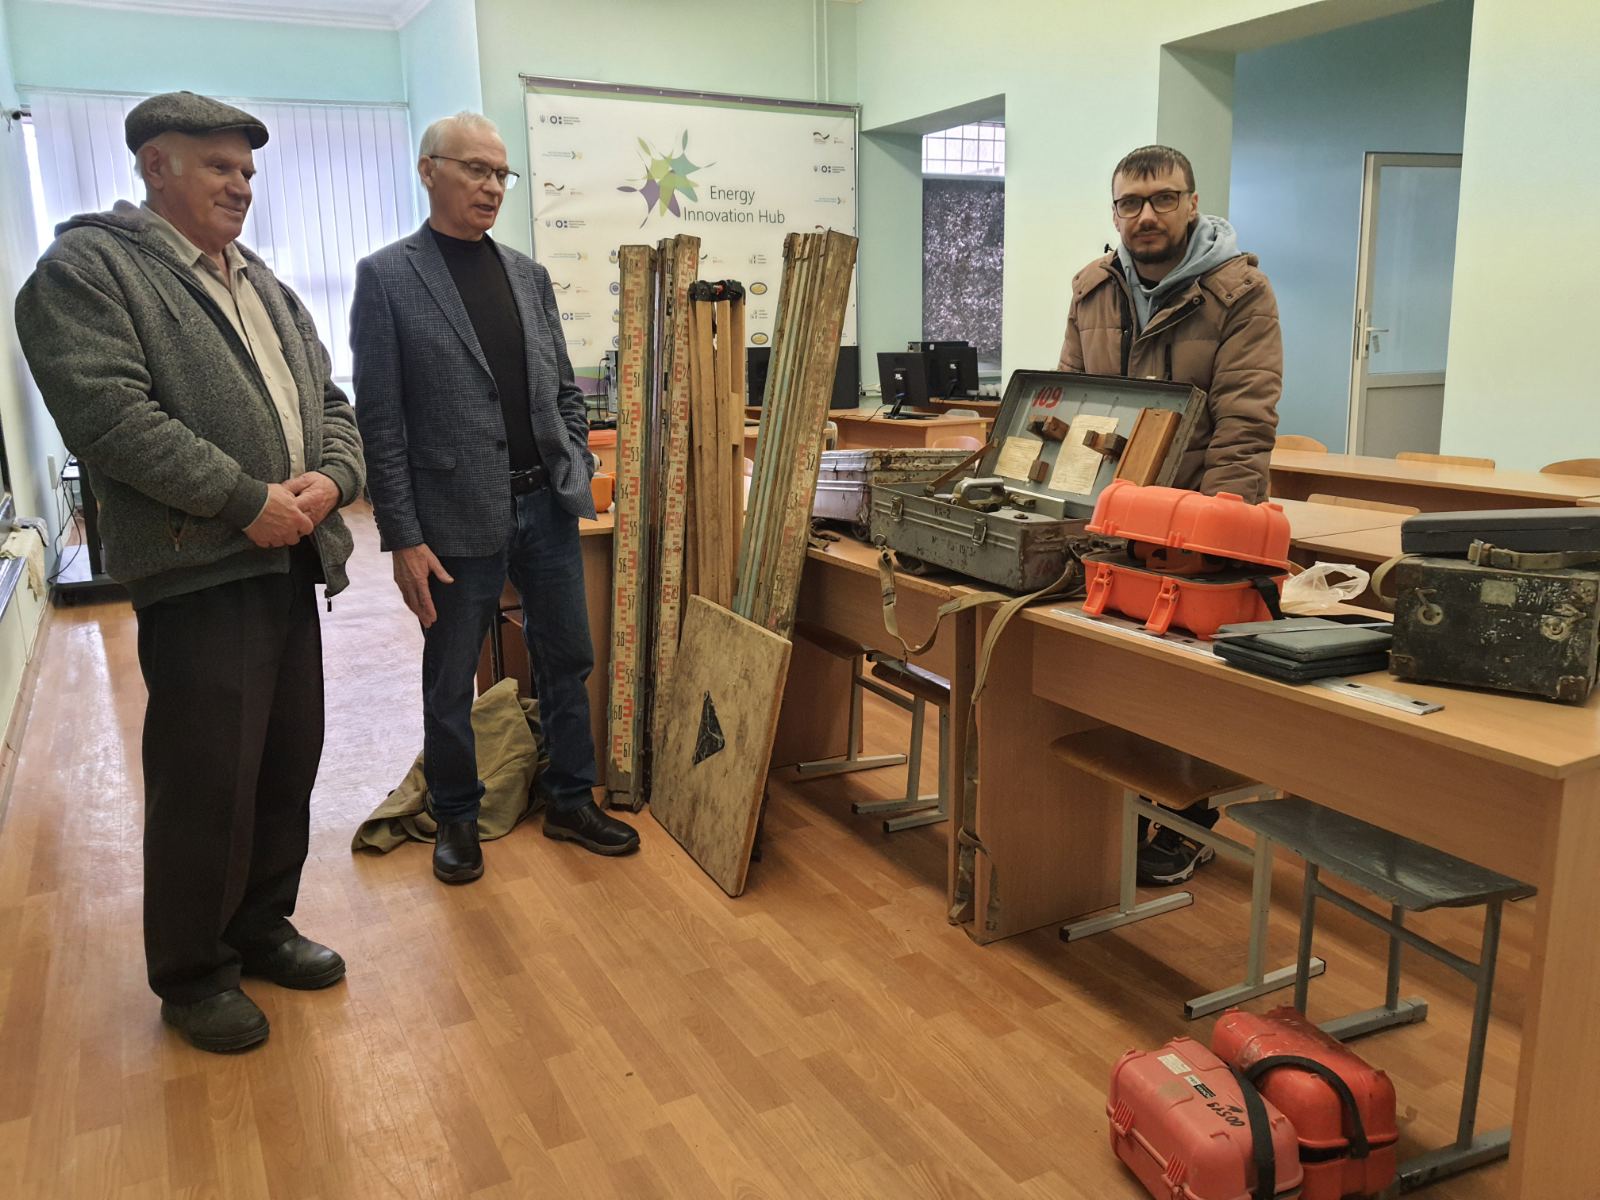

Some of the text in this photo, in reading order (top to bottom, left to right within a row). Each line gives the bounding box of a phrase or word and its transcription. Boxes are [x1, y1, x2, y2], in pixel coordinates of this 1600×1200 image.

[710, 185, 755, 205] Energy
[683, 206, 785, 224] Innovation Hub
[633, 372, 640, 387] 51
[1032, 386, 1063, 408] 109
[621, 409, 630, 424] 52
[630, 447, 639, 461] 53
[806, 453, 816, 471] 52
[620, 484, 629, 499] 54
[629, 521, 638, 537] 55
[618, 557, 627, 573] 56
[627, 594, 635, 610] 57
[616, 631, 625, 647] 58
[614, 705, 623, 721] 60
[623, 742, 632, 758] 61
